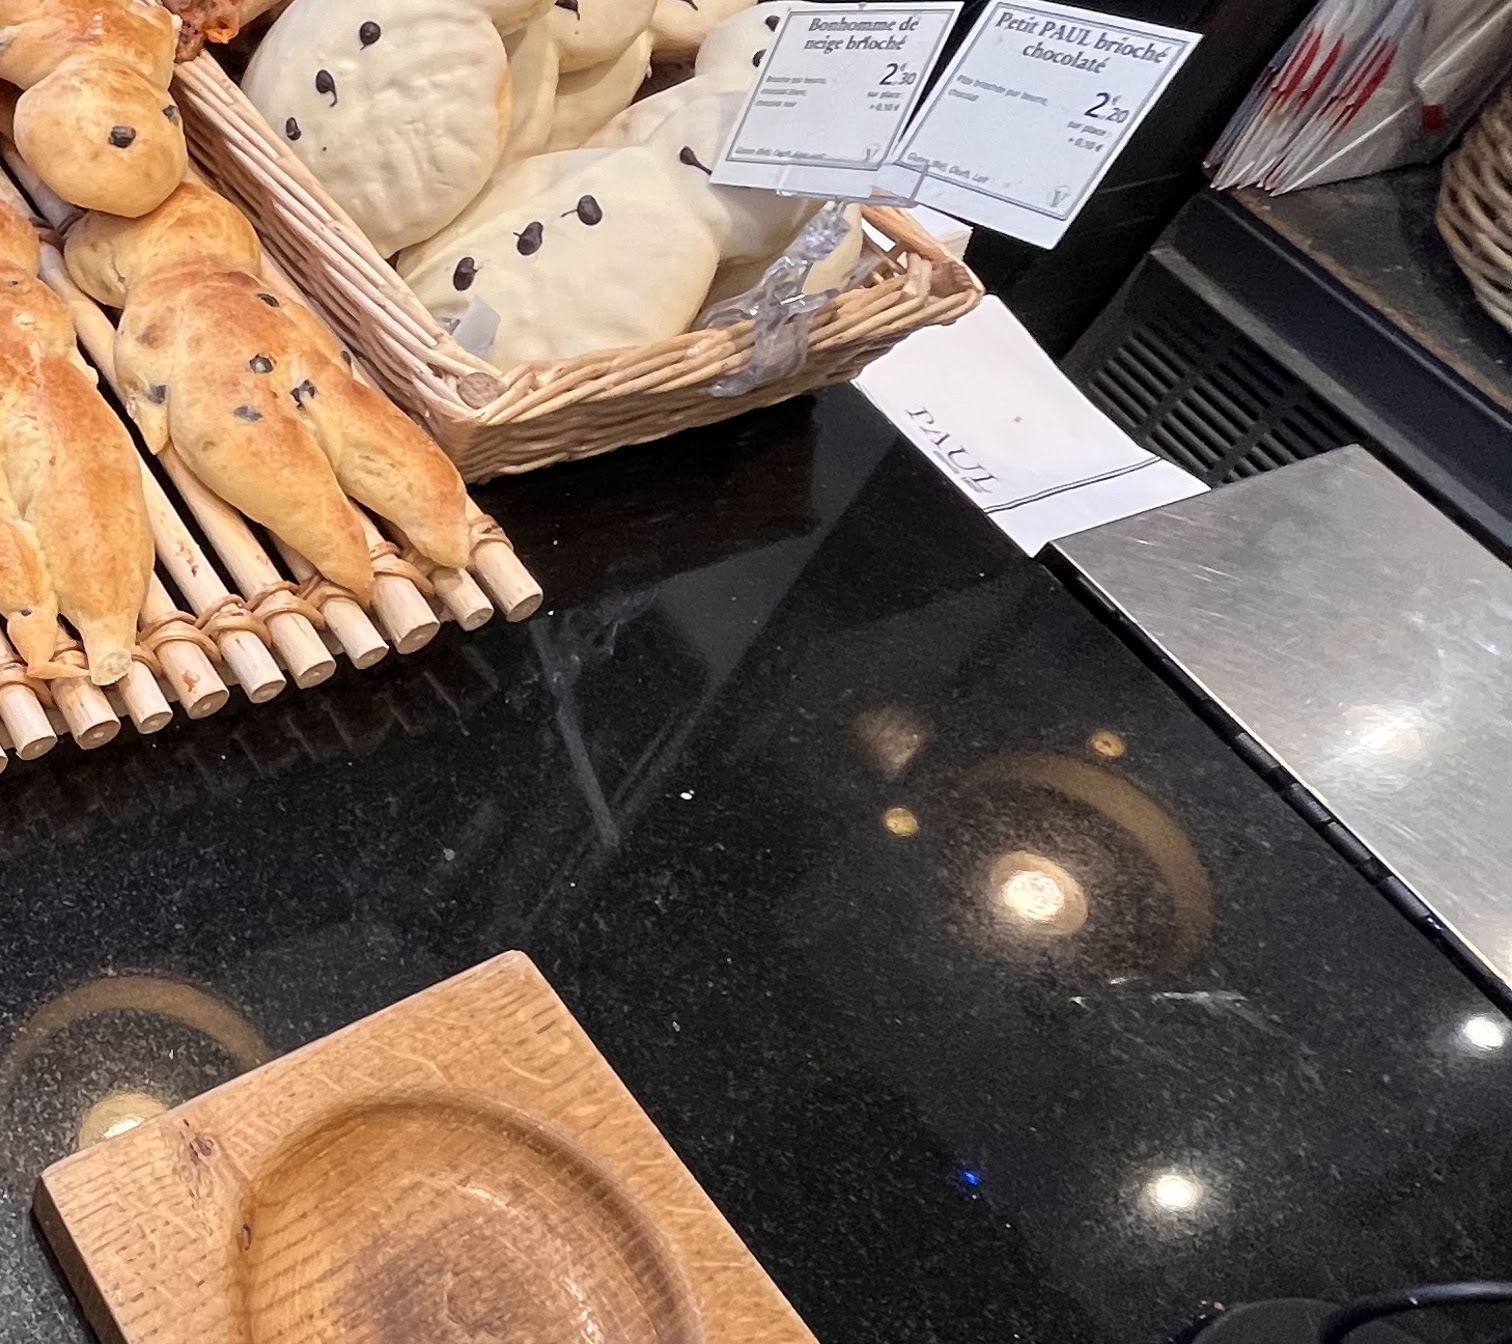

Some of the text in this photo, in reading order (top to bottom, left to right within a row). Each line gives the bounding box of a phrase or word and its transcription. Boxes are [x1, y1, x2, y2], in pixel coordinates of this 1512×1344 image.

[808, 16, 920, 32] Bonhomme de
[994, 11, 1169, 64] Petit PAUL brioché
[803, 34, 908, 54] neige brioché
[1022, 42, 1111, 74] chocolaté
[904, 406, 1000, 494] PAUL
